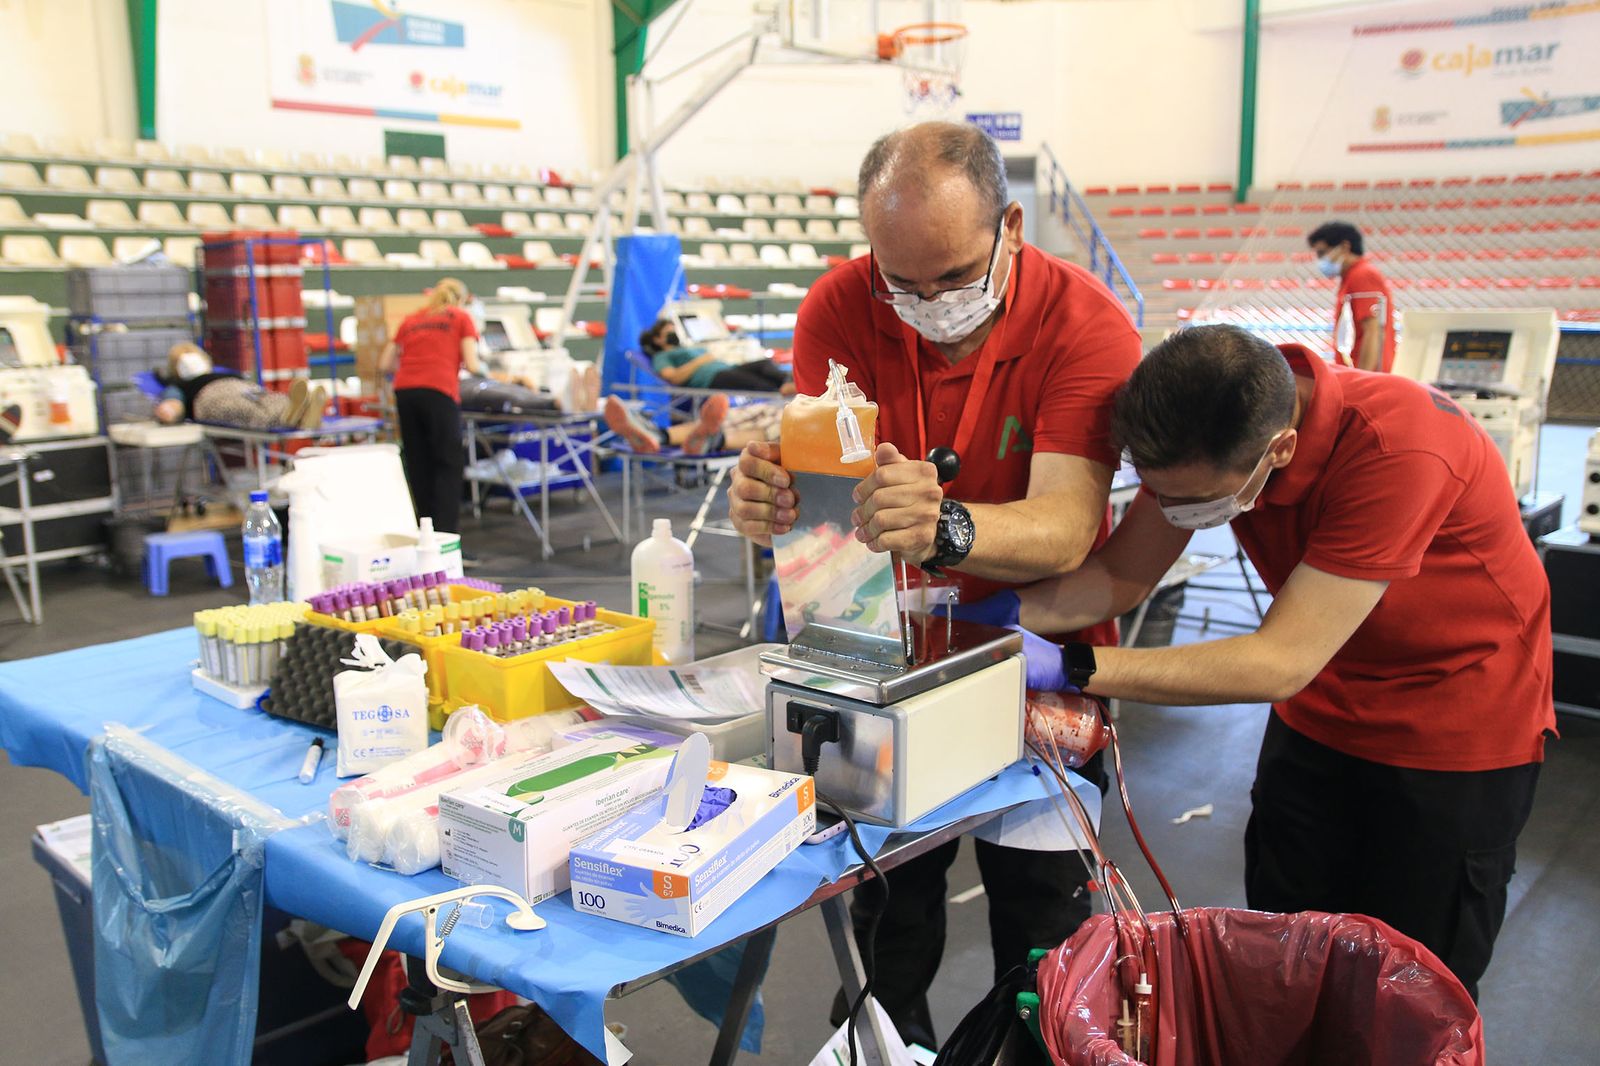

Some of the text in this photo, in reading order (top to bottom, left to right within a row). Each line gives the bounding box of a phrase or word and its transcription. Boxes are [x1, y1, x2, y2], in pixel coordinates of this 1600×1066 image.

[1431, 42, 1561, 77] cajamar
[595, 793, 616, 806] Iberian
[616, 788, 629, 798] care
[513, 822, 522, 836] M
[574, 857, 623, 877] Sensiflex
[695, 854, 727, 887] Sensiflex
[663, 875, 672, 889] S
[578, 891, 606, 909] 100
[656, 920, 687, 934] Bimedica
